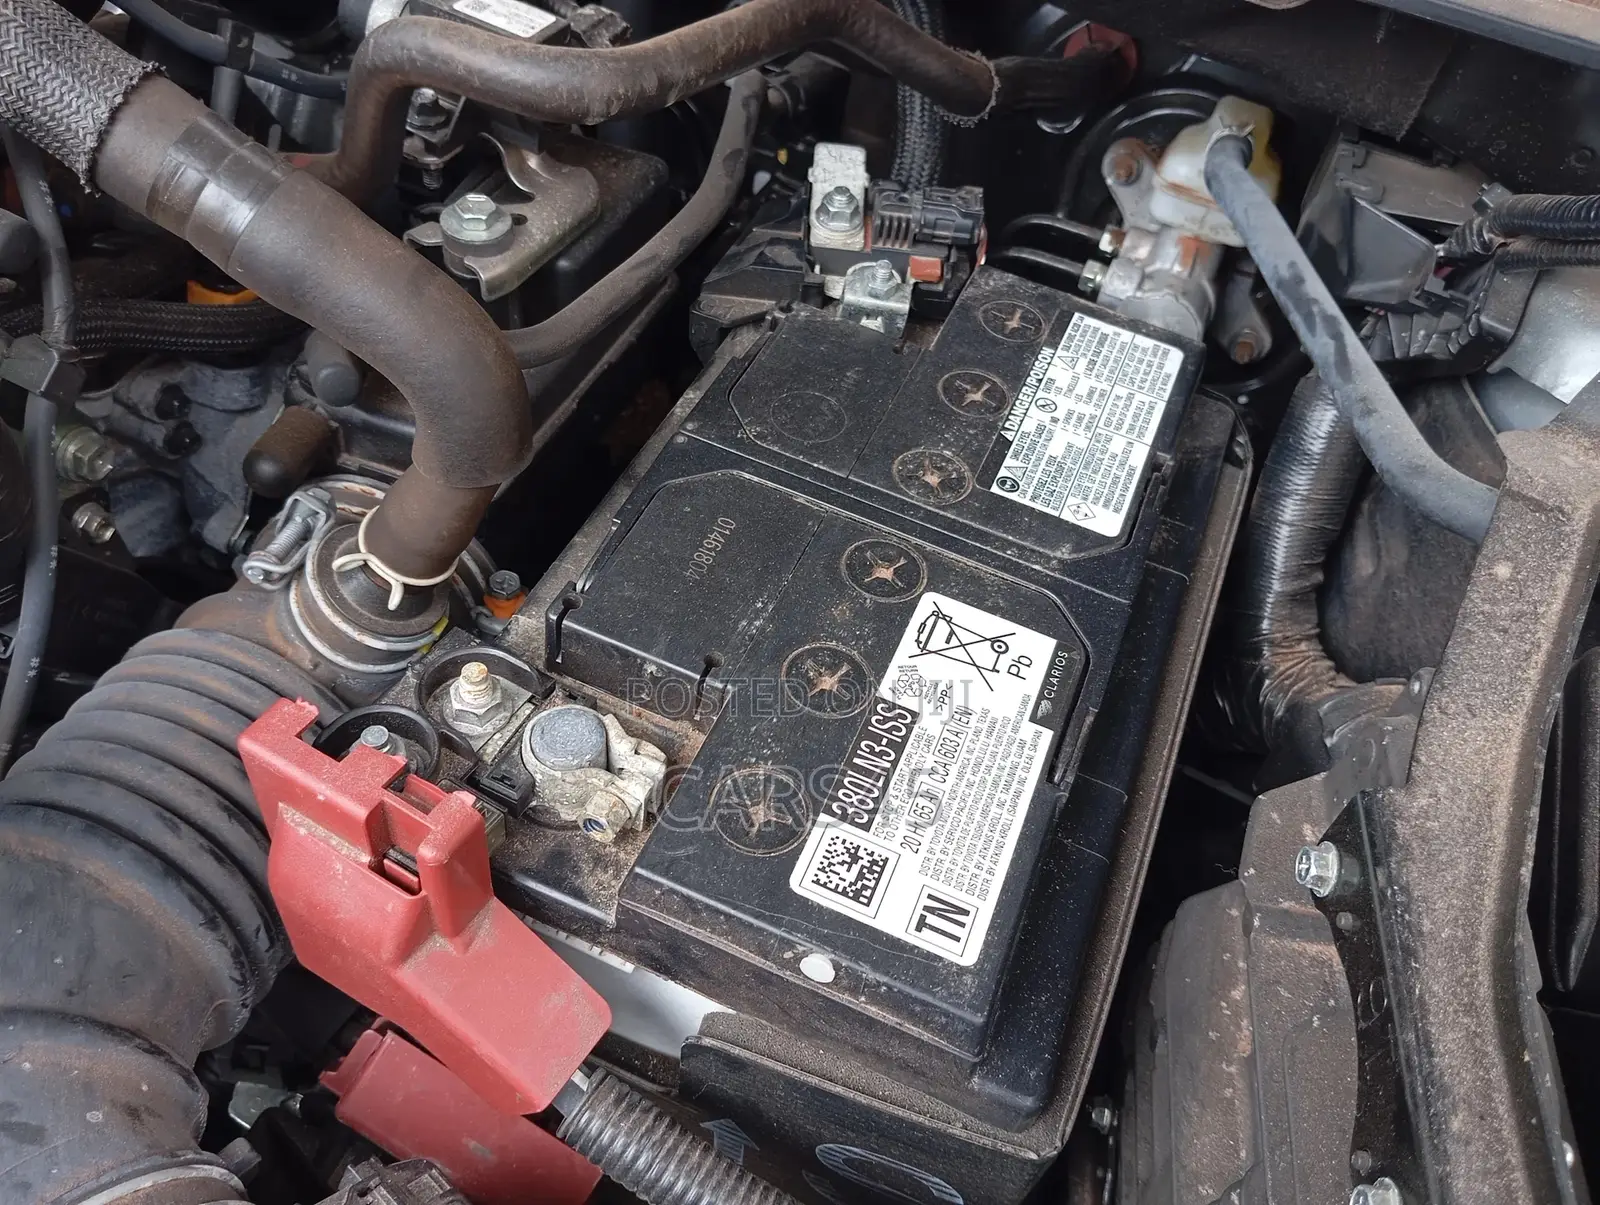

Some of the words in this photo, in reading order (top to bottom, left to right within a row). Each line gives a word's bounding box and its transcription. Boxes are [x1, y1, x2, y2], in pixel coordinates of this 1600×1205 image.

[1003, 346, 1054, 431] DANGER/POISON
[683, 518, 736, 579] 01461804
[1006, 651, 1033, 680] Pb
[1043, 649, 1068, 699] CLARIOS
[949, 702, 977, 730] (EN)
[983, 715, 998, 740] HAWAII
[920, 732, 935, 753] CARS
[944, 726, 964, 739] A
[1027, 728, 1042, 753] SAIPAN
[936, 735, 960, 760] 603
[1012, 737, 1027, 759] GUAM
[829, 700, 913, 826] 380LN3-ISS
[906, 753, 927, 788] FRIENDLY
[927, 757, 951, 784] CCA
[872, 821, 887, 838] FOR
[880, 799, 896, 821] STOP
[891, 767, 909, 793] START
[902, 724, 927, 768] APPLICABLE
[899, 787, 913, 804] ECO
[954, 789, 971, 817] PACIFIC
[888, 803, 906, 831] OTHER
[912, 802, 934, 821] 65
[986, 809, 1002, 834] KROLL
[883, 830, 896, 842] TO
[906, 818, 928, 837] Hr
[943, 815, 961, 846] SERVCO
[997, 815, 1013, 840] KROLL
[899, 834, 922, 854] 20
[939, 844, 951, 856] BY
[977, 832, 994, 860] ATKINS
[988, 838, 1005, 866] ATKINS
[973, 858, 985, 871] BY
[985, 864, 997, 876] BY
[914, 893, 970, 944] TN
